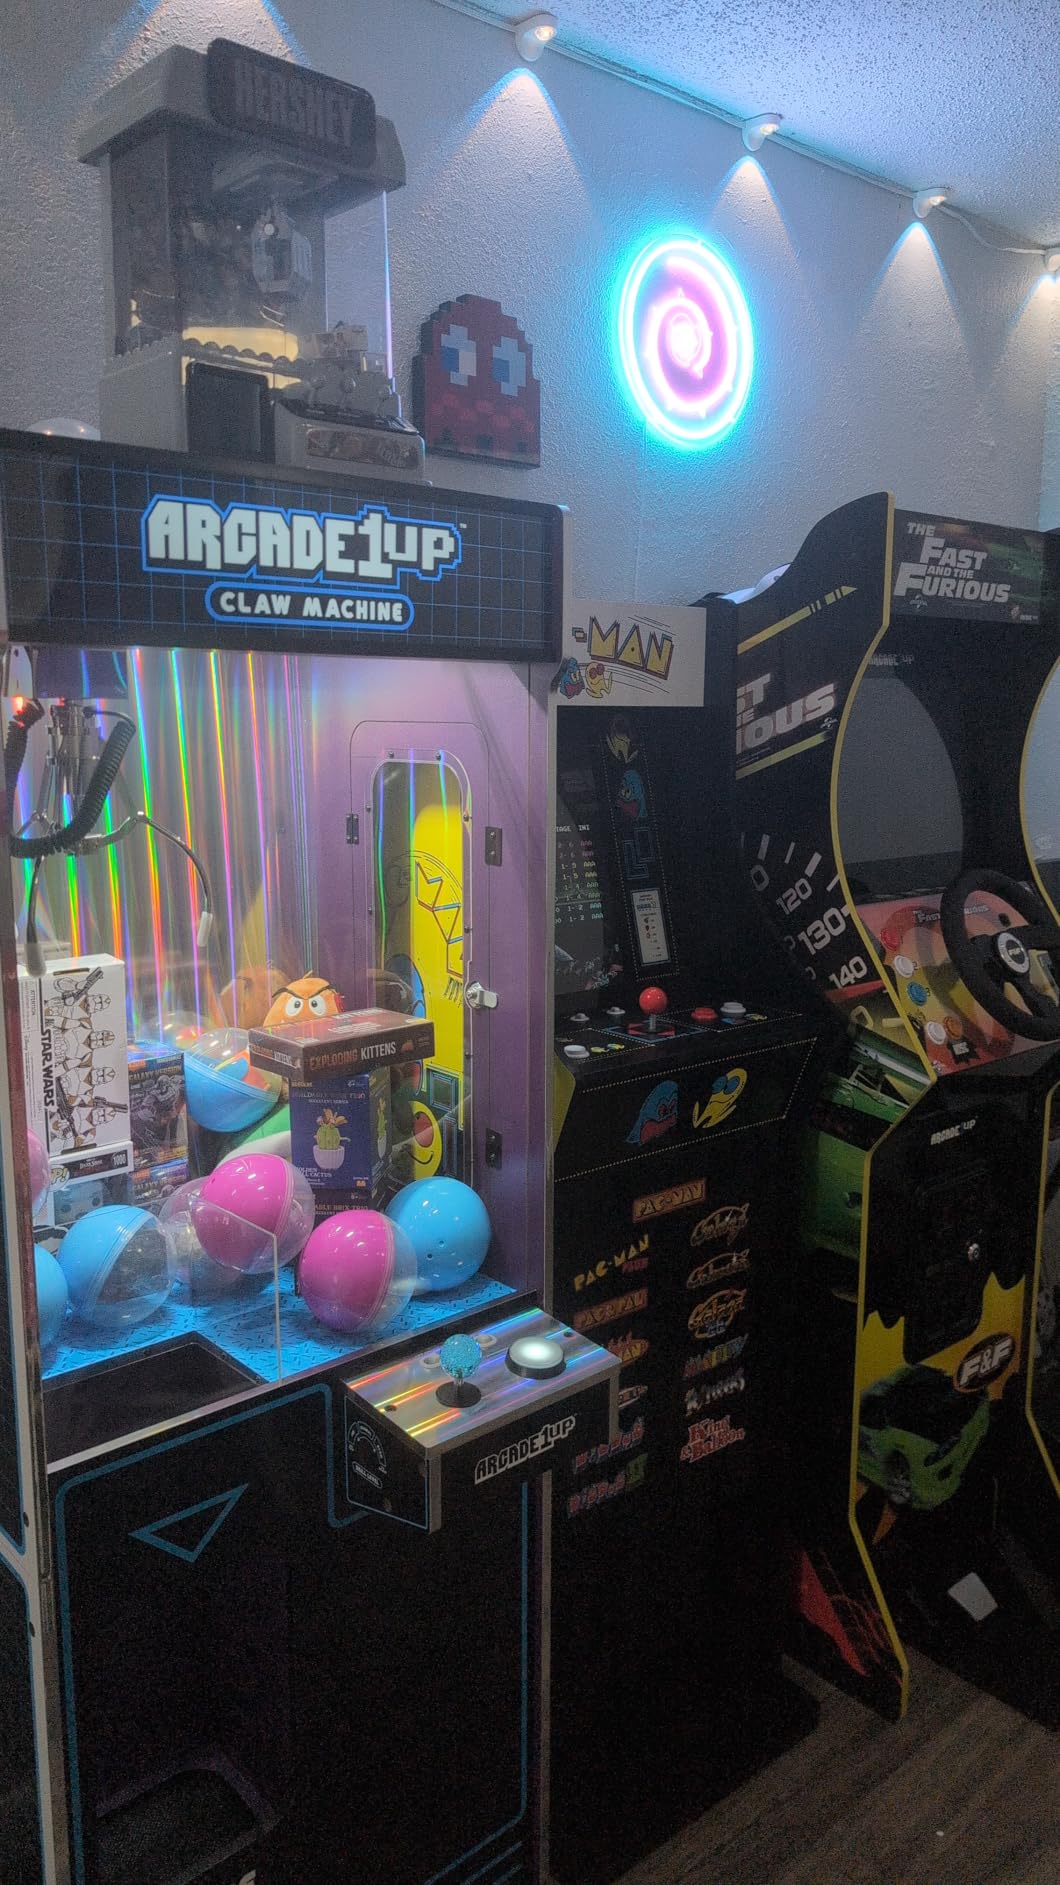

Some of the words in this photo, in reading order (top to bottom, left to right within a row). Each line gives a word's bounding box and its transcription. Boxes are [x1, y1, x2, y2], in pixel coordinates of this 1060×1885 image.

[233, 58, 355, 147] HERSHEY
[149, 500, 455, 578] ARCADE1UP
[907, 522, 936, 536] THE
[919, 537, 987, 570] FAST
[926, 566, 951, 576] AND
[954, 569, 974, 579] THE
[894, 562, 1011, 603] FURIOUS
[220, 591, 291, 616] CLAW
[303, 597, 403, 622] MACHINE
[776, 878, 812, 915] 120
[797, 907, 846, 955] 130
[828, 955, 867, 989] 140
[40, 1029, 53, 1066] STAR
[309, 1048, 358, 1071] EXPLODING
[361, 1042, 397, 1060] KITTENS
[42, 1065, 55, 1109] WARS
[573, 1234, 650, 1292] PAC-MAN
[960, 1338, 1013, 1386] F&F
[475, 1415, 576, 1485] ARCADE1UP
